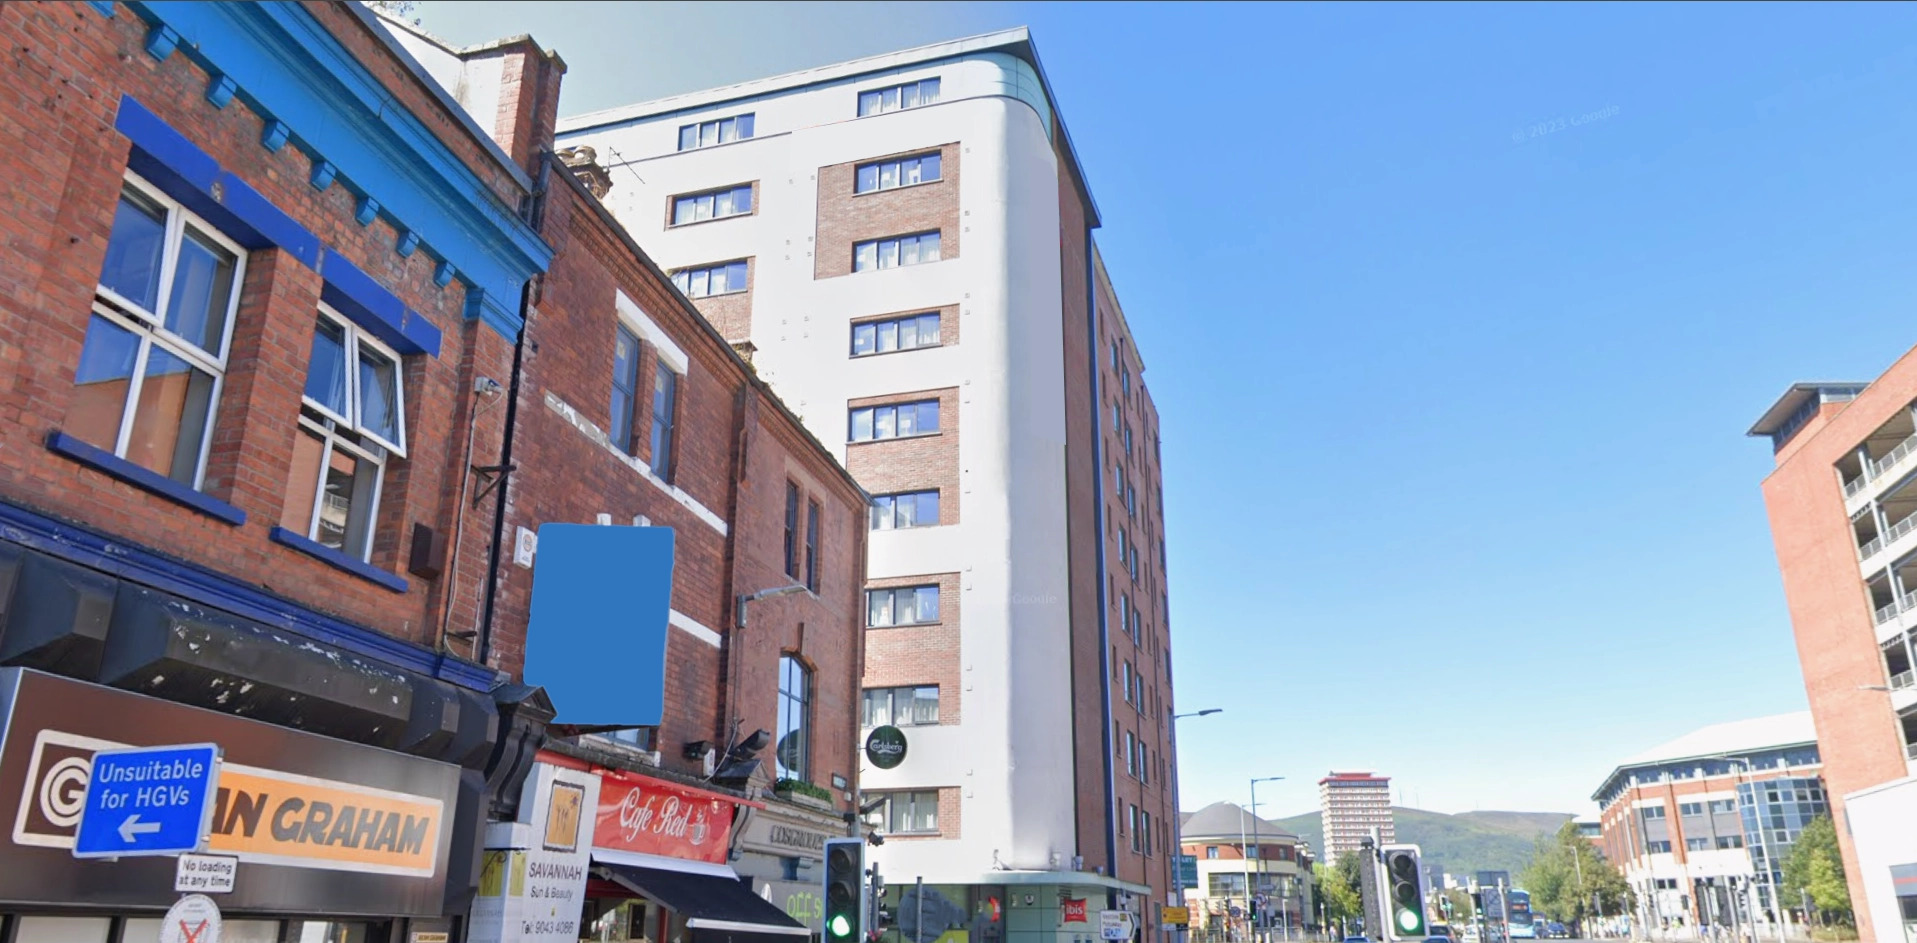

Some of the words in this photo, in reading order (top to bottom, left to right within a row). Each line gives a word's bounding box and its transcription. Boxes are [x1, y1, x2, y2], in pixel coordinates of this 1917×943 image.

[870, 738, 903, 754] Carlsberg
[99, 762, 203, 783] Unsuitable
[100, 789, 129, 809] for
[135, 785, 190, 808] HGVs
[620, 787, 655, 843] Cafe
[653, 796, 693, 837] Red
[270, 796, 430, 855] GRAHAM
[183, 860, 196, 871] No
[199, 861, 232, 874] loading
[529, 862, 582, 880] SAVANNAH
[179, 876, 188, 885] at
[191, 877, 208, 887] any
[211, 875, 231, 887] time
[530, 885, 543, 898] Sun
[551, 887, 573, 902] Beauty
[1066, 904, 1083, 915] ibis
